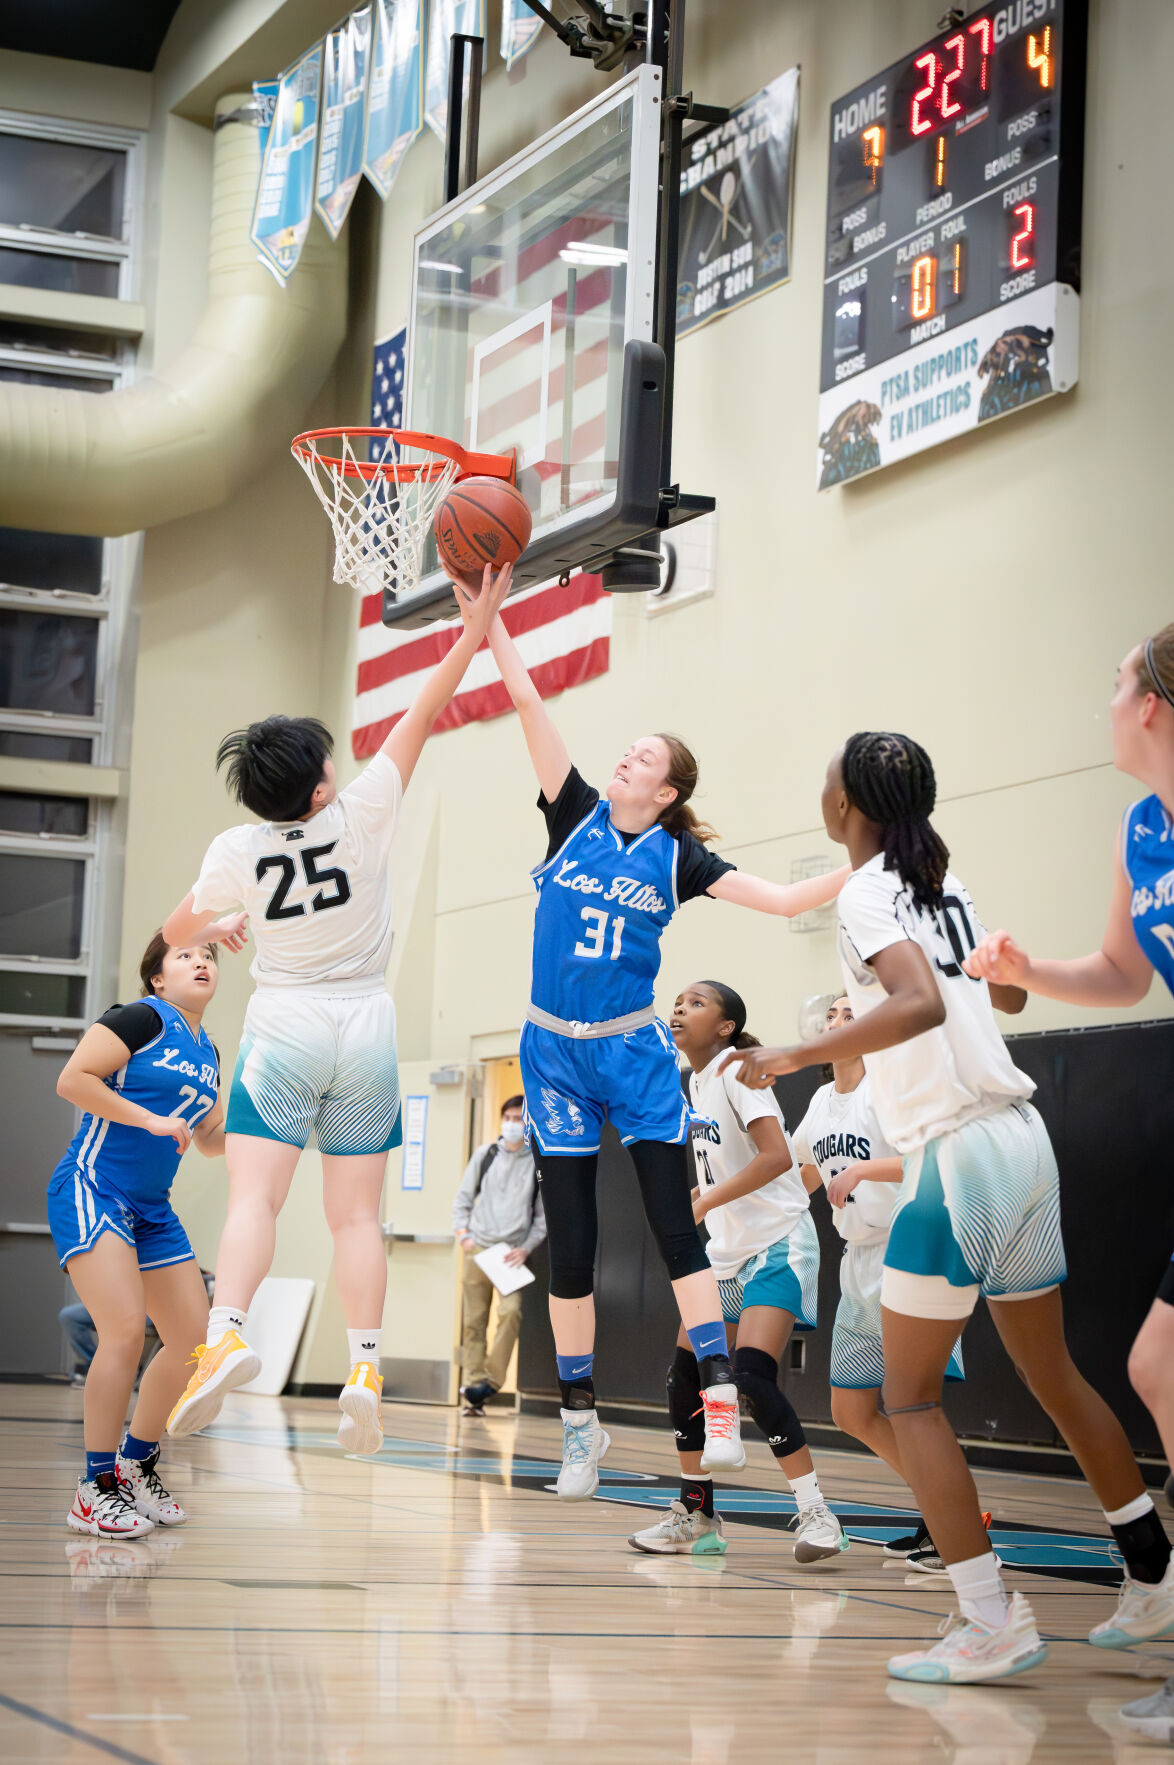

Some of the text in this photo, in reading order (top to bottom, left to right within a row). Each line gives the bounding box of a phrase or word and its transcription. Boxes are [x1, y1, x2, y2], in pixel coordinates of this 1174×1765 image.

[1028, 26, 1051, 88] 4
[833, 84, 887, 143] HOME
[1007, 111, 1038, 141] POSS
[936, 136, 945, 186] 1
[984, 147, 1021, 181] BONUS
[916, 192, 952, 225] PERIOD
[1003, 176, 1037, 209] FOULS
[842, 207, 867, 234] POSS
[853, 221, 886, 253] BONUS
[941, 215, 966, 241] FOUL
[1012, 204, 1033, 268] 2
[896, 231, 935, 265] PLAYER
[838, 267, 868, 296] FOULS
[912, 256, 933, 318] 0
[1000, 270, 1036, 301] SCORE
[910, 314, 946, 344] MATCH
[834, 353, 866, 381] SCORE
[881, 337, 978, 408] PTSA SUPPORTS
[890, 381, 971, 442] EV ATHLETICS
[254, 838, 353, 921] 25
[552, 859, 667, 914] Los Altos
[573, 906, 626, 960] 31
[152, 1048, 198, 1077] Los
[812, 1133, 870, 1168] COUGARS
